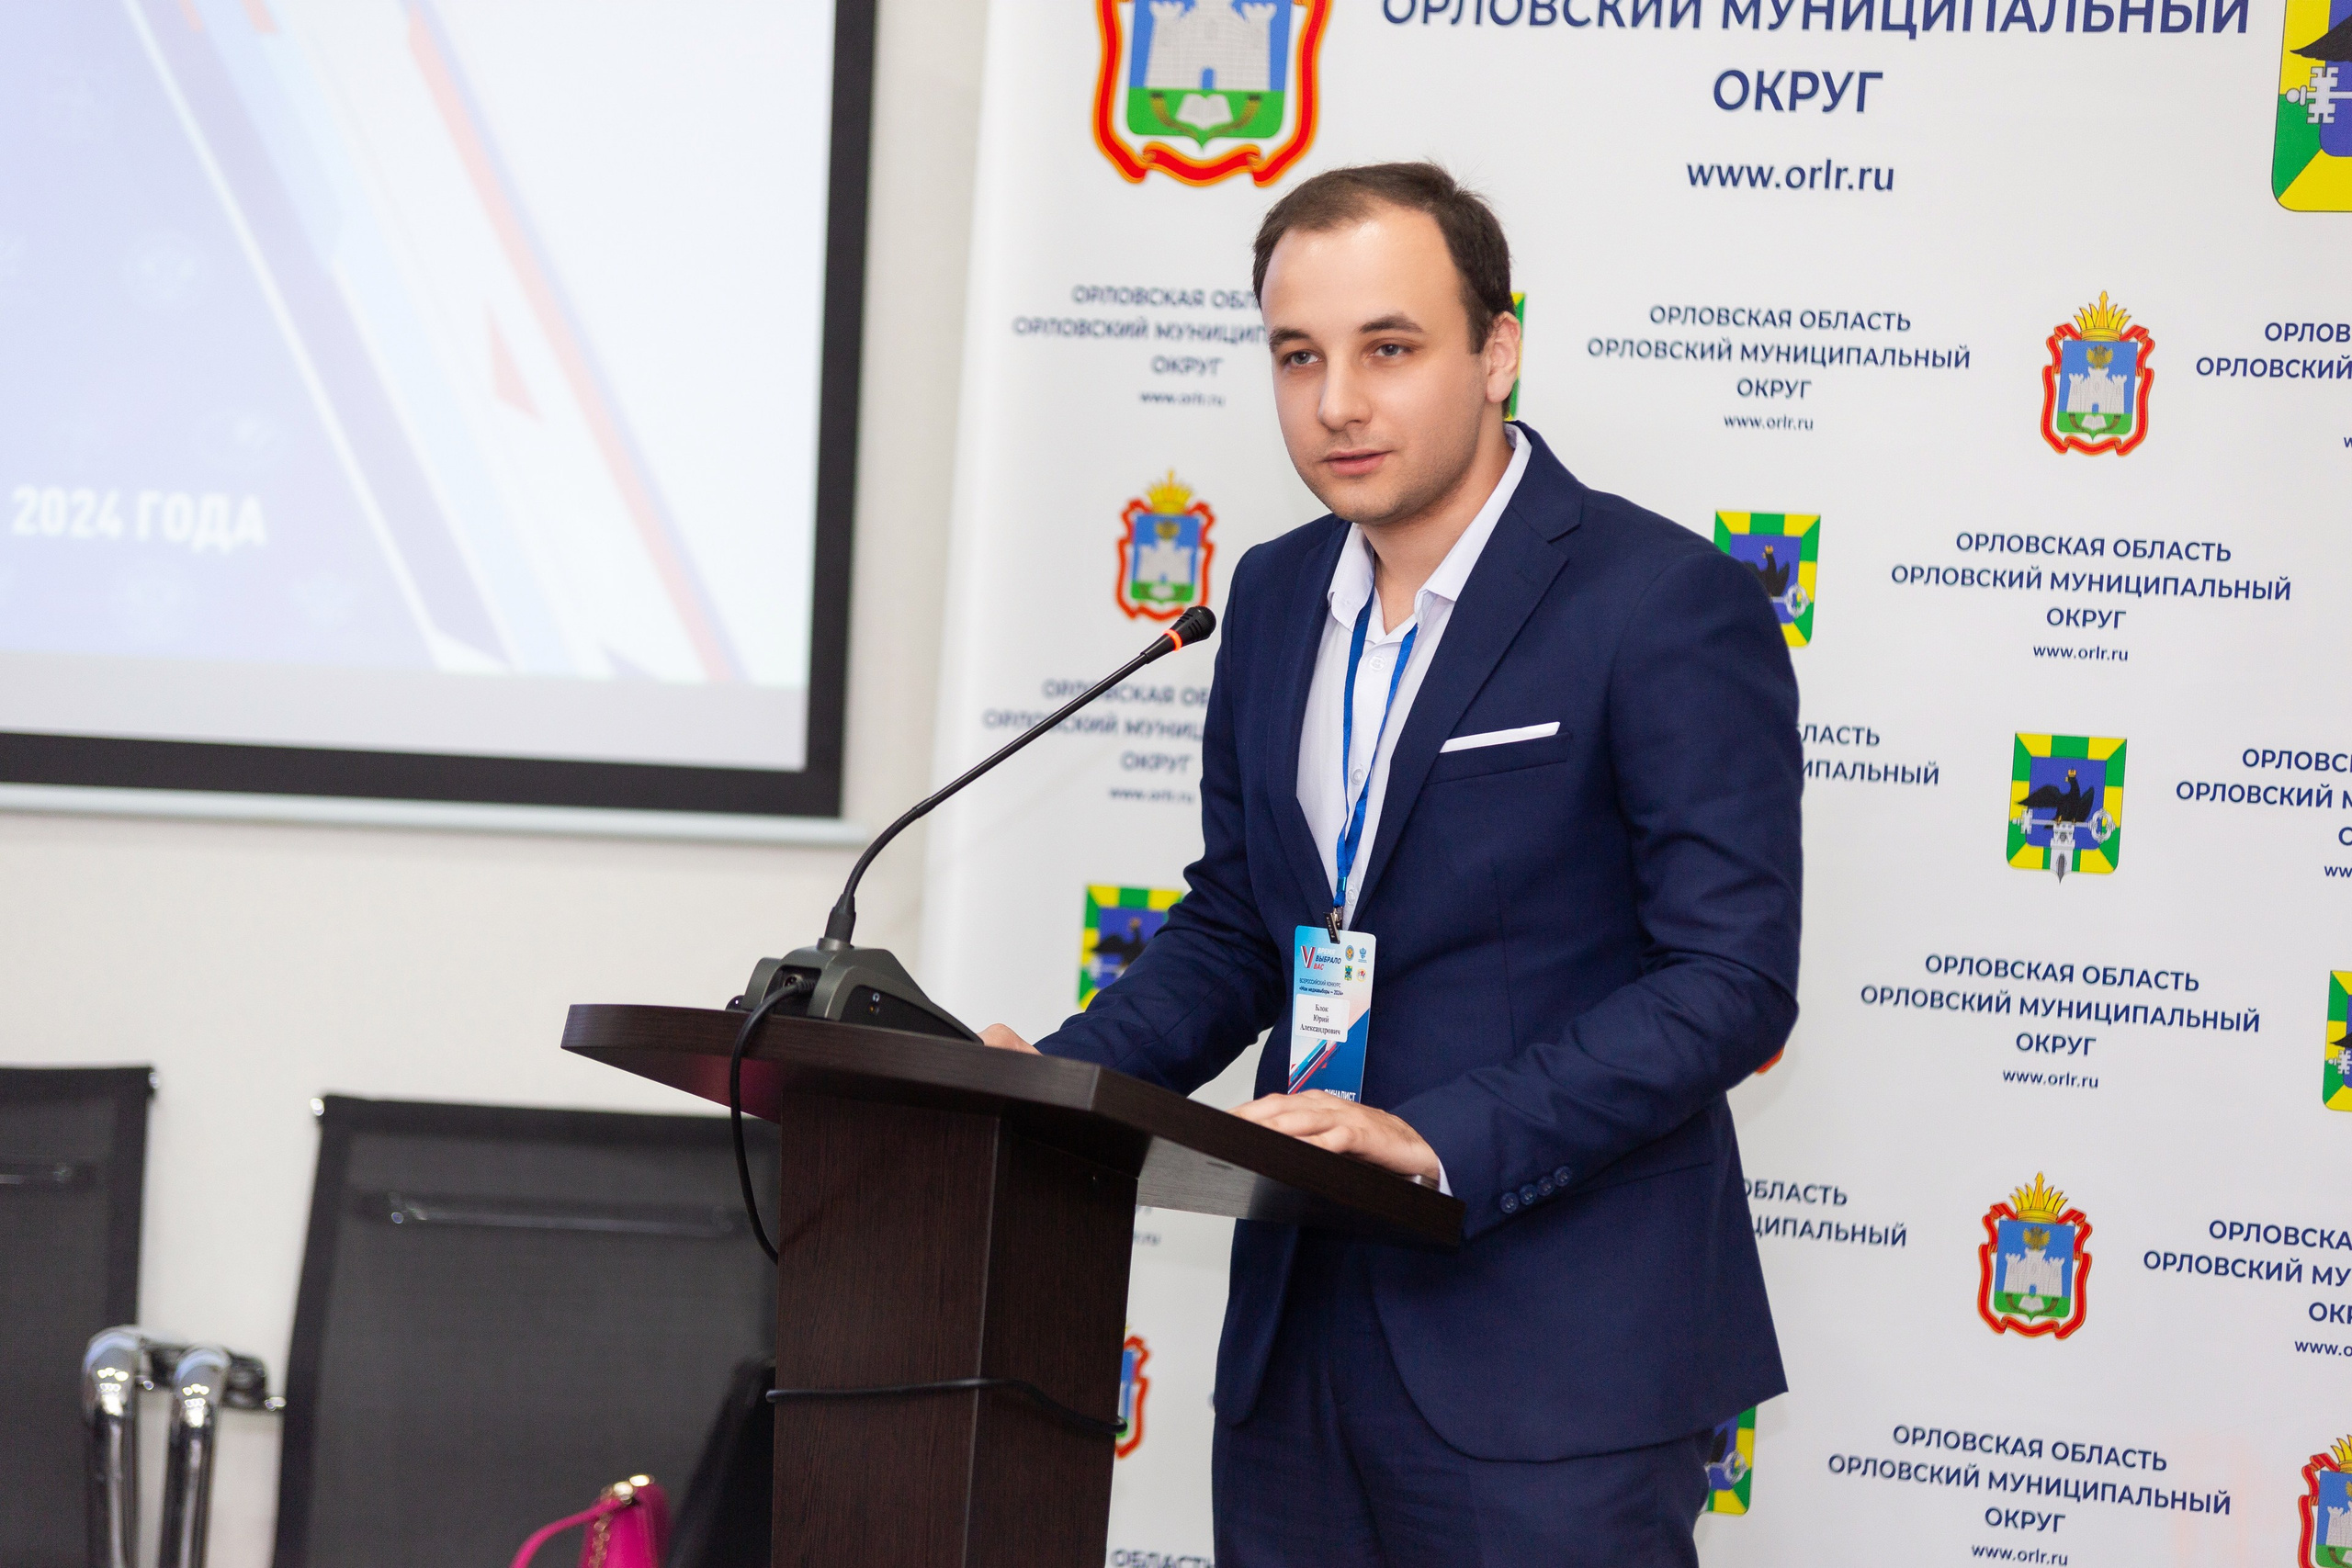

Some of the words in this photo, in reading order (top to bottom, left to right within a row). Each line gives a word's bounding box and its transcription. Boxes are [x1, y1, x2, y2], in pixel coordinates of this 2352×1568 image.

[1713, 68, 1884, 113] ОКРУГ
[1687, 157, 1894, 191] www.orlr.ru
[1071, 285, 1204, 308] ОРЛОВСКАЯ
[1649, 305, 1792, 329] ОРЛОВСКАЯ
[1799, 310, 1911, 332] ОБЛАСТЬ
[1588, 338, 1733, 361] ОРЛОВСКИЙ
[1740, 344, 1971, 369] МУНИЦИПАЛЬНЫЙ
[2196, 355, 2352, 380] ОРЛОВСКИЙ
[1736, 378, 1813, 399] ОКРУГ
[1724, 415, 1815, 431] www.orlr.ru
[11, 483, 124, 540] 2024
[136, 489, 267, 555] ГОДА
[1956, 532, 2106, 557] ОРЛОВСКАЯ
[2112, 538, 2232, 562] ОБЛАСТЬ
[1891, 565, 2042, 590] ОРЛОВСКИЙ
[2050, 571, 2291, 601] МУНИЦИПАЛЬНЫЙ
[2046, 607, 2128, 629] ОКРУГ
[2032, 646, 2130, 661] www.orlr.ru
[1798, 722, 1881, 748] ЛАСТЬ
[2242, 748, 2352, 773] ОРЛОВС
[2176, 781, 2334, 808] ОРЛОВСКИЙ
[1313, 963, 1325, 971] ВАС
[1315, 955, 1342, 964] ВЫБРАЛО
[1925, 954, 2075, 983] ОРЛОВСКАЯ
[2082, 965, 2200, 992] ОБЛАСТЬ
[1313, 1014, 1329, 1023] Юрий
[1315, 1003, 1329, 1012] Блок
[1860, 985, 2011, 1014] ОРЛОВСКИЙ
[2019, 997, 2260, 1032] МУНИЦИПАЛЬНЫЙ
[1300, 1023, 1340, 1035] Александрович
[2016, 1032, 2097, 1056] ОКРУГ
[2002, 1071, 2099, 1089] www.orlr.ru
[2143, 1250, 2303, 1283] ОРЛОВСКИЙ
[1893, 1425, 2044, 1459] ОРЛОВСКАЯ
[2051, 1441, 2167, 1472] ОБЛАСТЬ
[1828, 1454, 1980, 1488] ОРЛОВСКИЙ
[1988, 1471, 2231, 1516] МУНИЦИПАЛЬНЫЙ
[1984, 1506, 2066, 1533] ОКРУГ
[1972, 1545, 2068, 1566] www.orlr.ru
